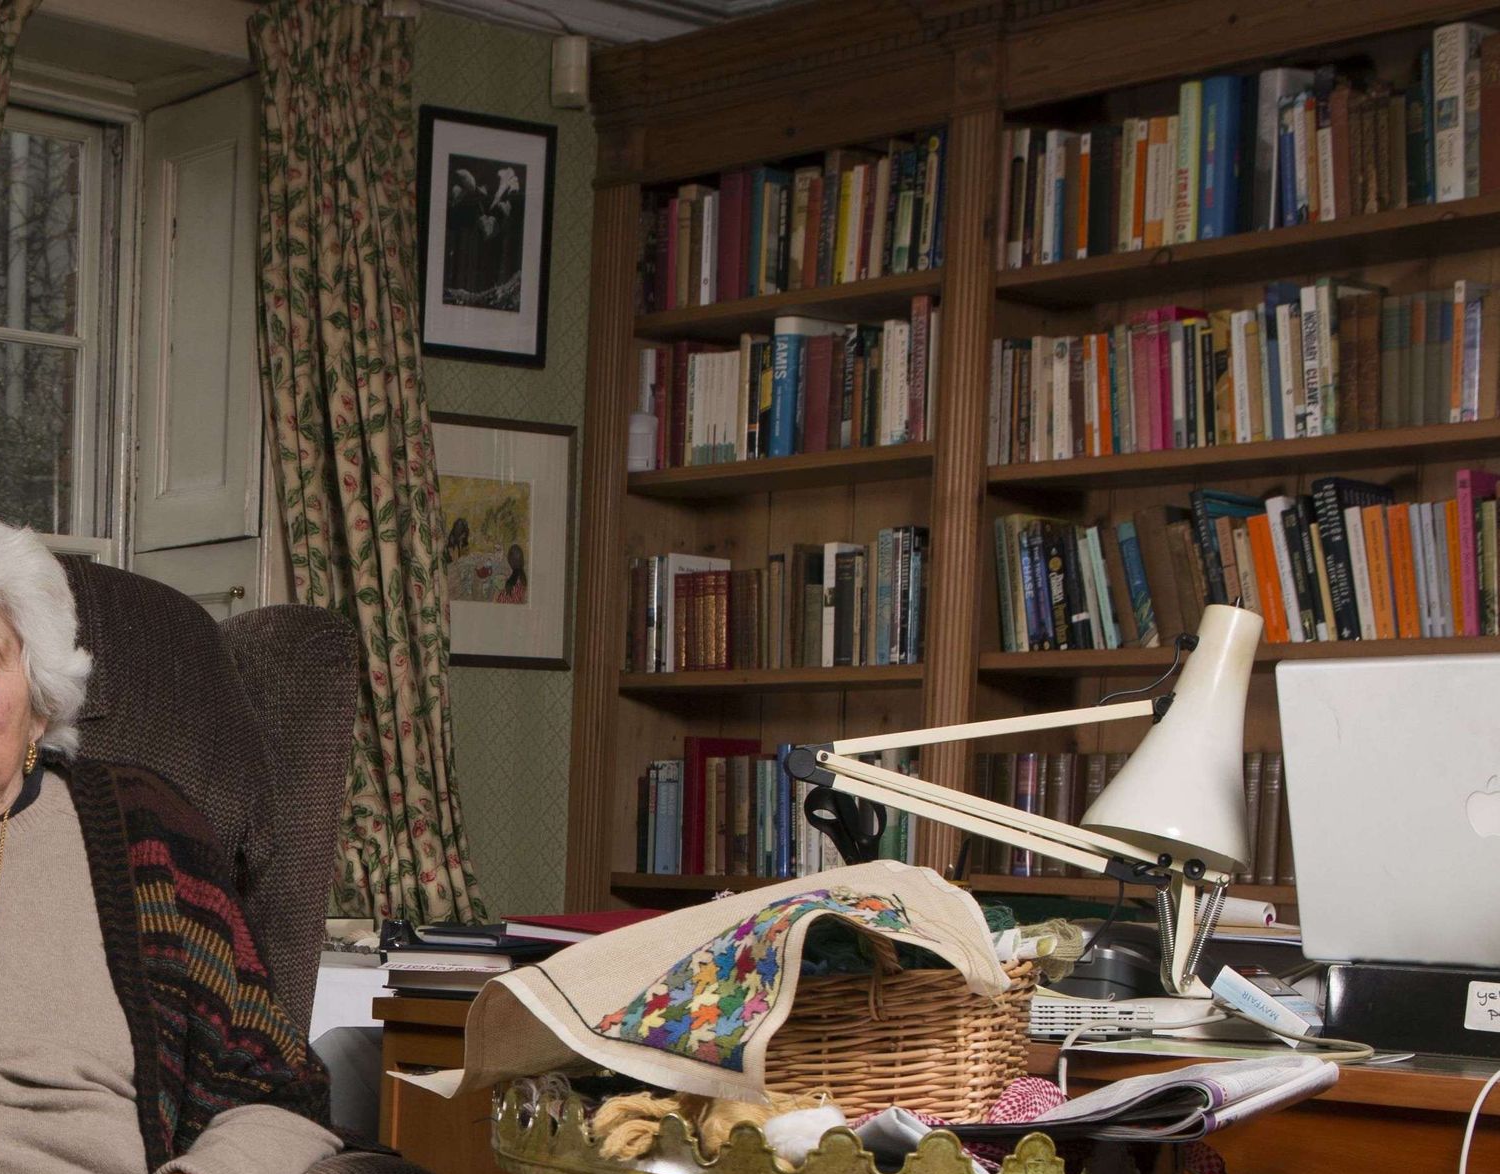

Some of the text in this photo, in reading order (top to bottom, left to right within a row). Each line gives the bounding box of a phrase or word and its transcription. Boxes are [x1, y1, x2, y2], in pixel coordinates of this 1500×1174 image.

[1176, 168, 1191, 232] armadillo
[775, 342, 788, 380] AMIS
[914, 343, 925, 400] ATKINSON
[1304, 310, 1319, 407] INCENDIARY CLEAVE
[1323, 483, 1343, 542] ROBERTSON
[1022, 556, 1034, 600] CHASE
[1241, 989, 1280, 1022] MAYFAIR
